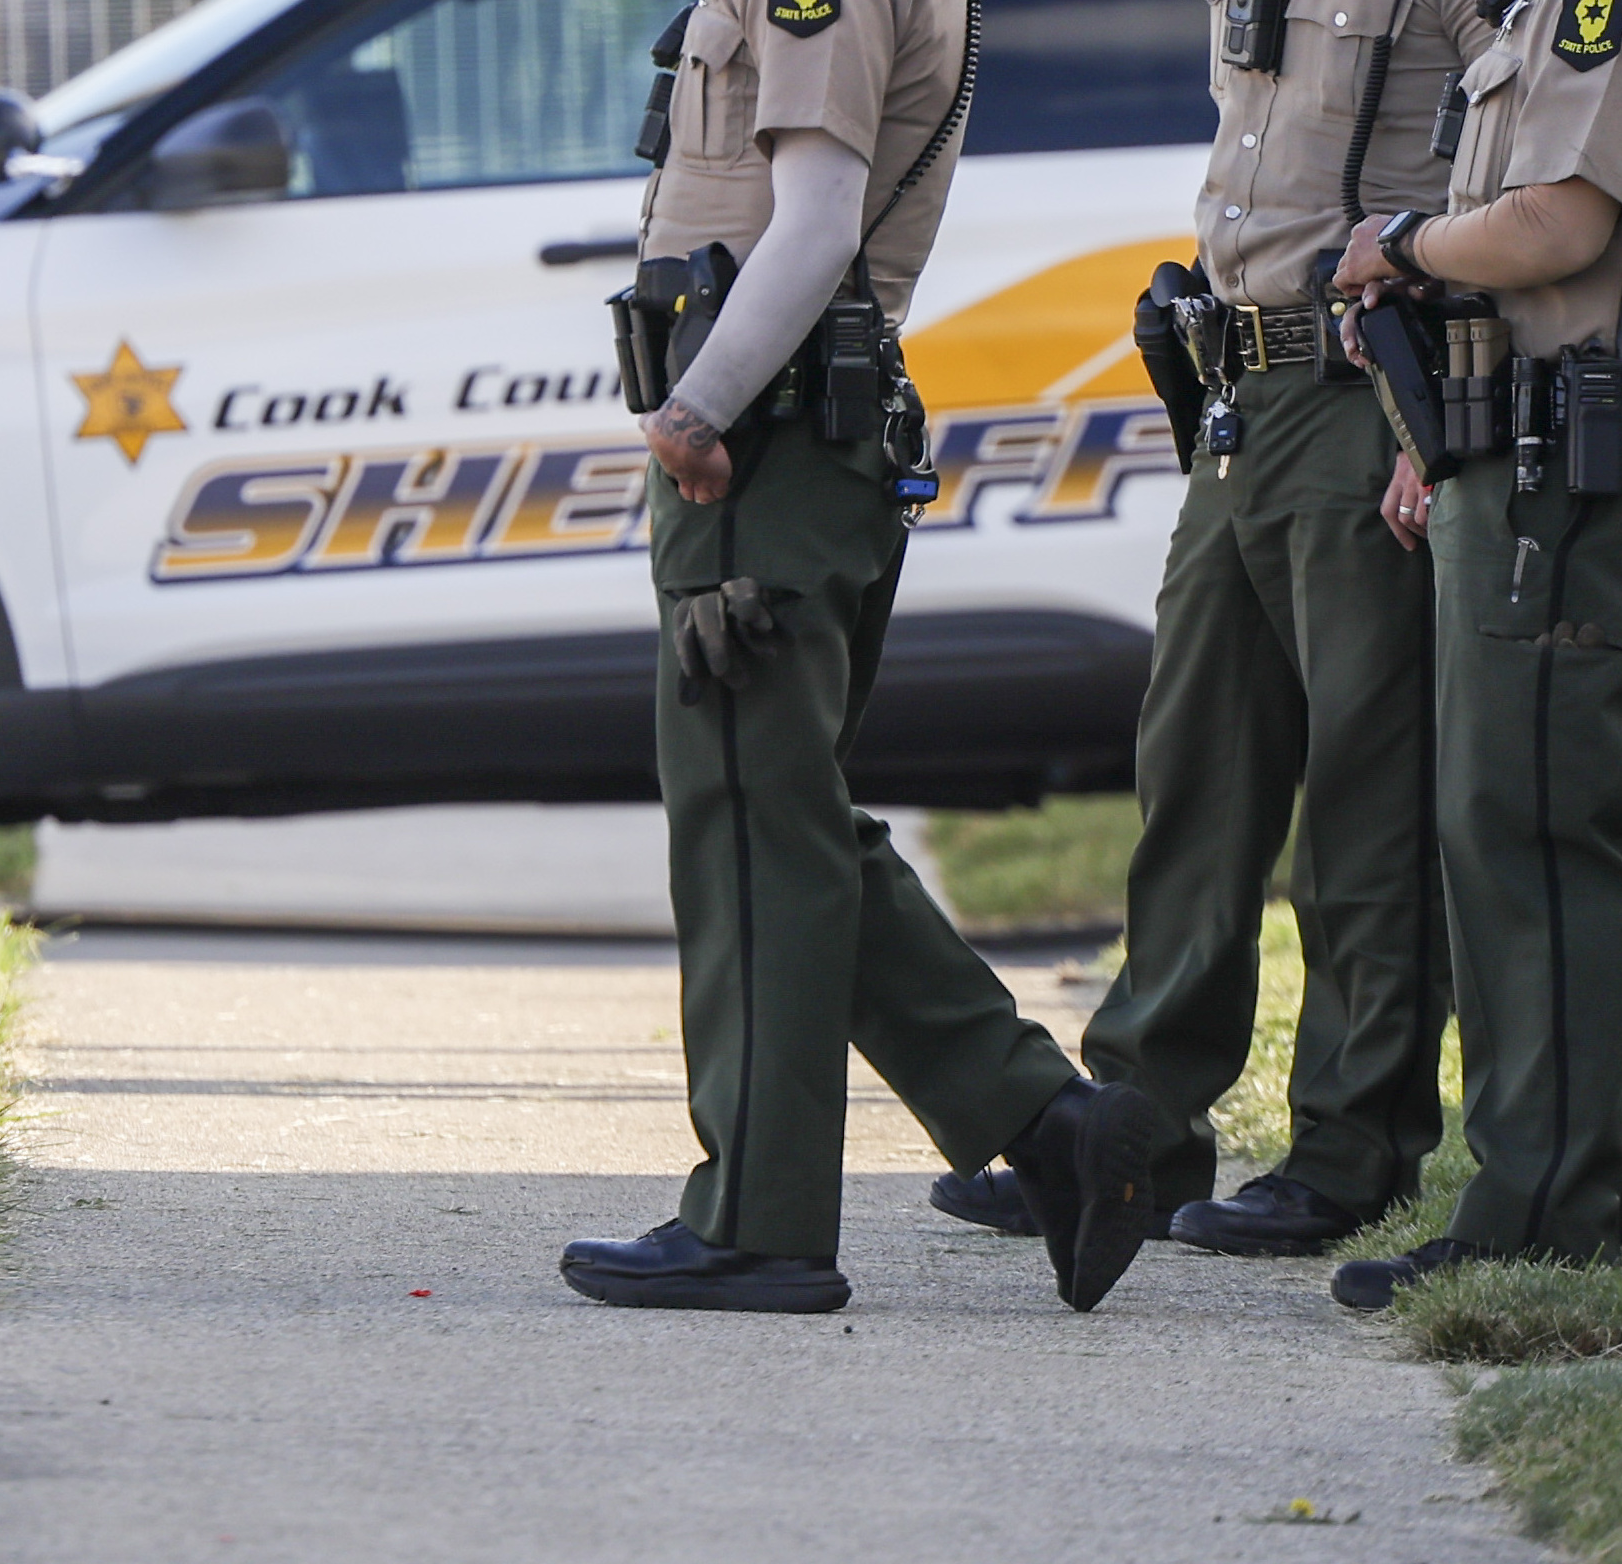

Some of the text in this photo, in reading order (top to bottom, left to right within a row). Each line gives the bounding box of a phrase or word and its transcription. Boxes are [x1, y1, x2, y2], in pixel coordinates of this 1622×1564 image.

[775, 3, 832, 20] STATE POLICE
[1559, 39, 1613, 54] STATE POLICE
[213, 365, 621, 431] Cook Cou
[150, 396, 1182, 584] SHEFF
